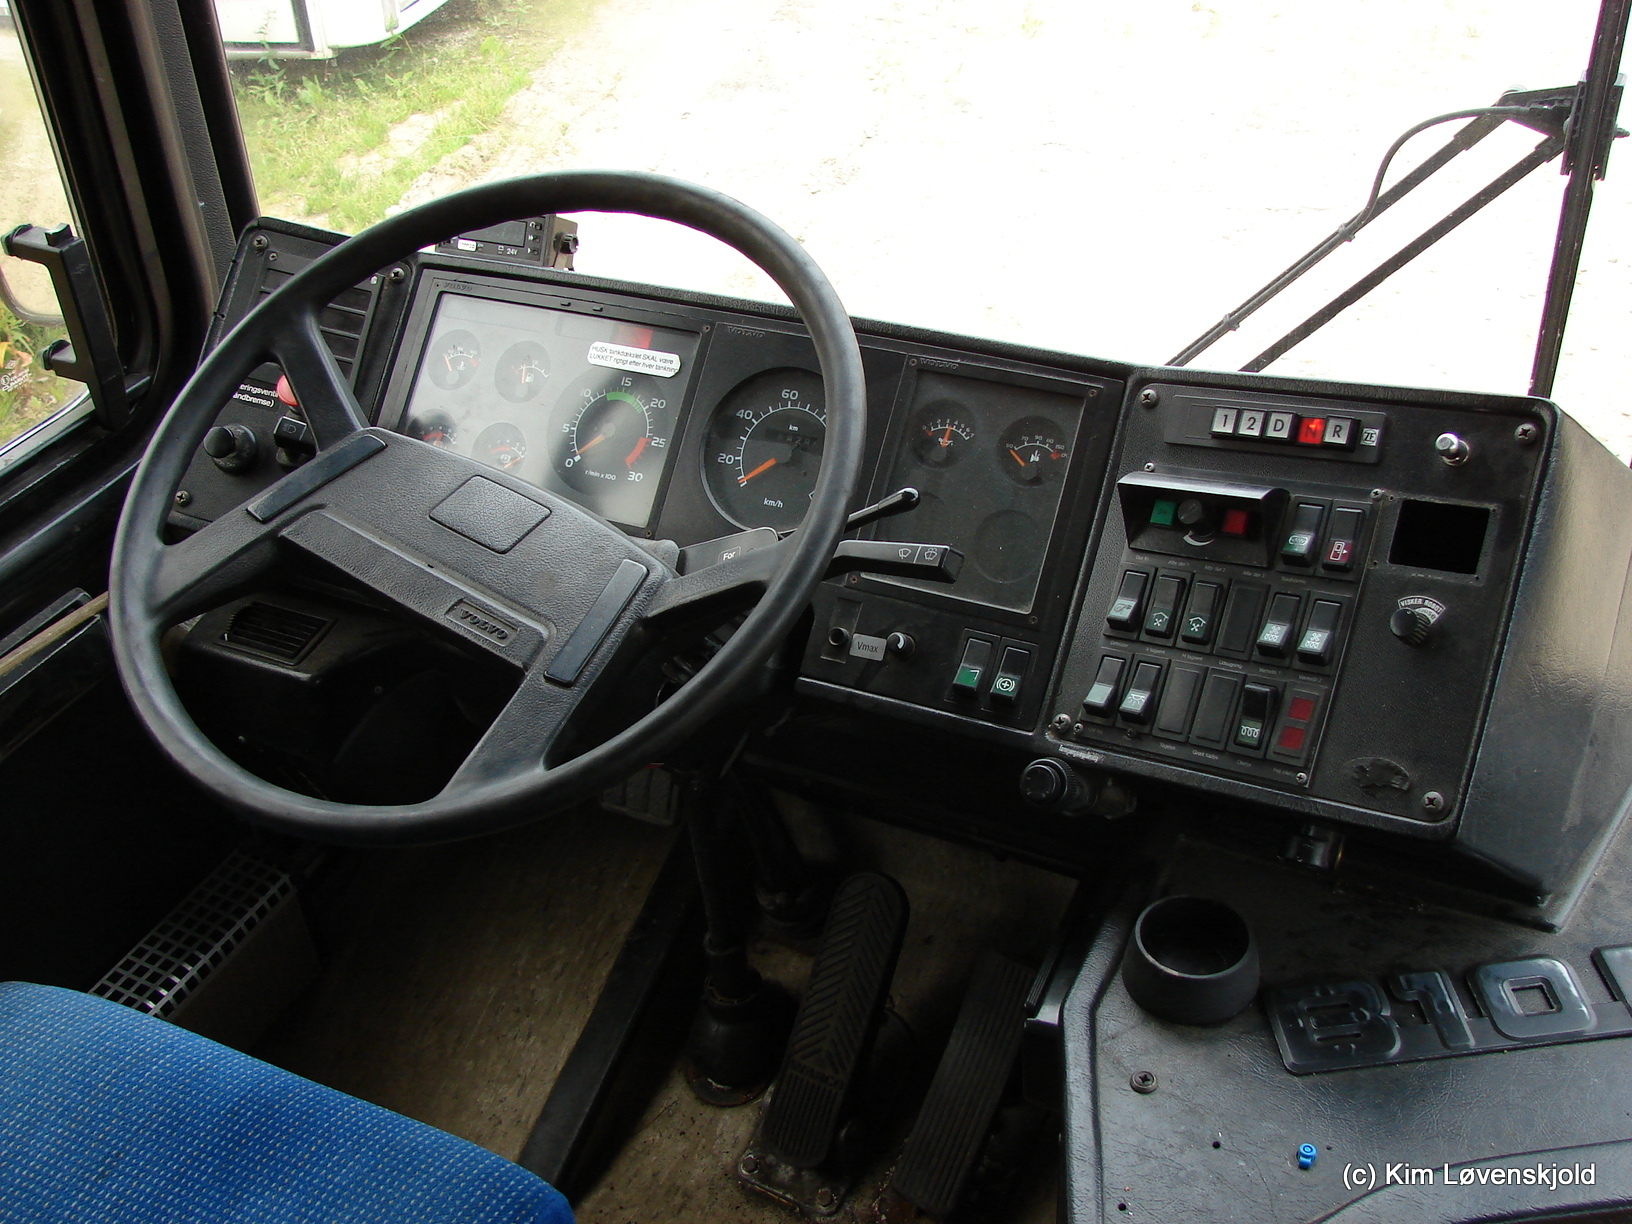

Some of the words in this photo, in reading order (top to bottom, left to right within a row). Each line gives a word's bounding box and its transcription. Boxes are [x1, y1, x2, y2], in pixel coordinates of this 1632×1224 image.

[727, 325, 765, 338] VOLVO
[592, 345, 608, 354] HUSK
[642, 353, 658, 363] SKAL
[589, 353, 613, 362] LUKKET
[642, 362, 655, 370] hver
[920, 357, 959, 370] VOLVO
[621, 376, 633, 387] 15
[232, 391, 275, 408] åndbremse)
[781, 389, 799, 400] 60
[650, 397, 666, 409] 20
[735, 409, 753, 420] 40
[1223, 414, 1228, 428] 1
[1246, 416, 1256, 431] 2
[1273, 419, 1285, 432] D
[562, 423, 571, 433] 5
[788, 424, 799, 432] km
[1332, 424, 1342, 439] R
[650, 436, 667, 448] 25
[1363, 432, 1376, 442] ZF
[565, 458, 574, 468] 0
[717, 453, 734, 465] 20
[605, 473, 617, 481] 100
[627, 471, 643, 482] 30
[763, 498, 783, 509] km/h
[722, 551, 736, 561] For
[1400, 598, 1423, 607] VISKER
[460, 608, 508, 640] VOLVO
[857, 641, 879, 654] Vmax
[1268, 944, 1632, 1072] B10
